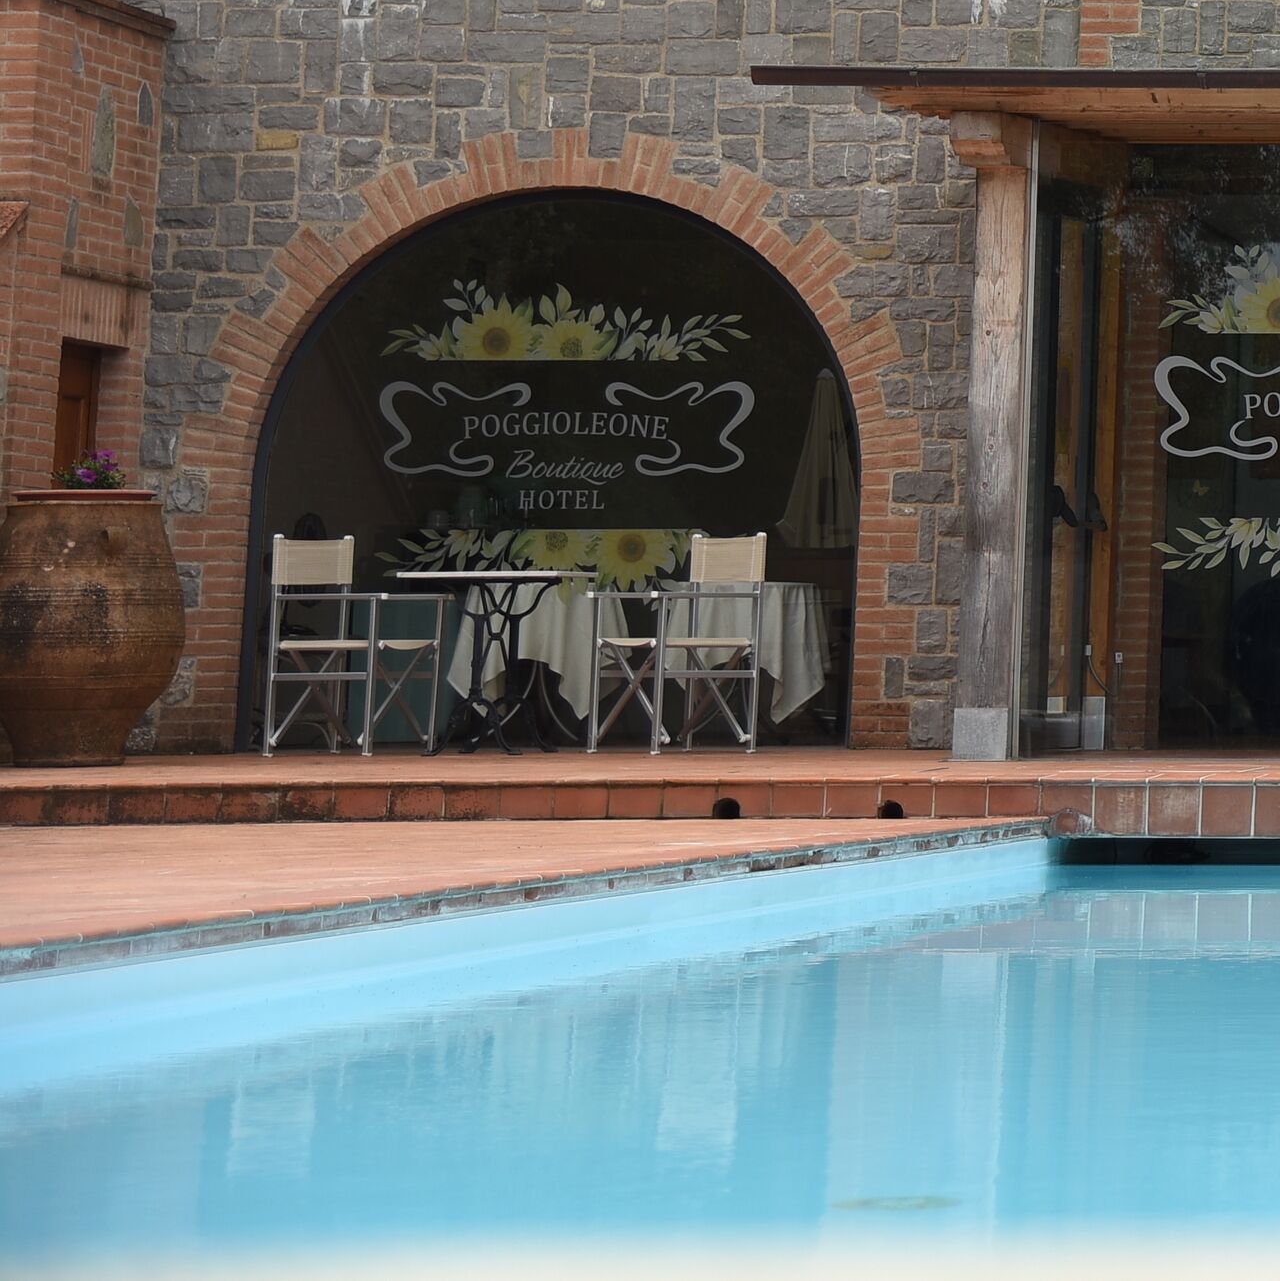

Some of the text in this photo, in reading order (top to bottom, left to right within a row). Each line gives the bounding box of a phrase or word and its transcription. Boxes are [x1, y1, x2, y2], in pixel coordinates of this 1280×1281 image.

[463, 411, 669, 440] POGGIOLEONE
[505, 449, 624, 485] Boutique
[518, 489, 605, 510] HOTEL
